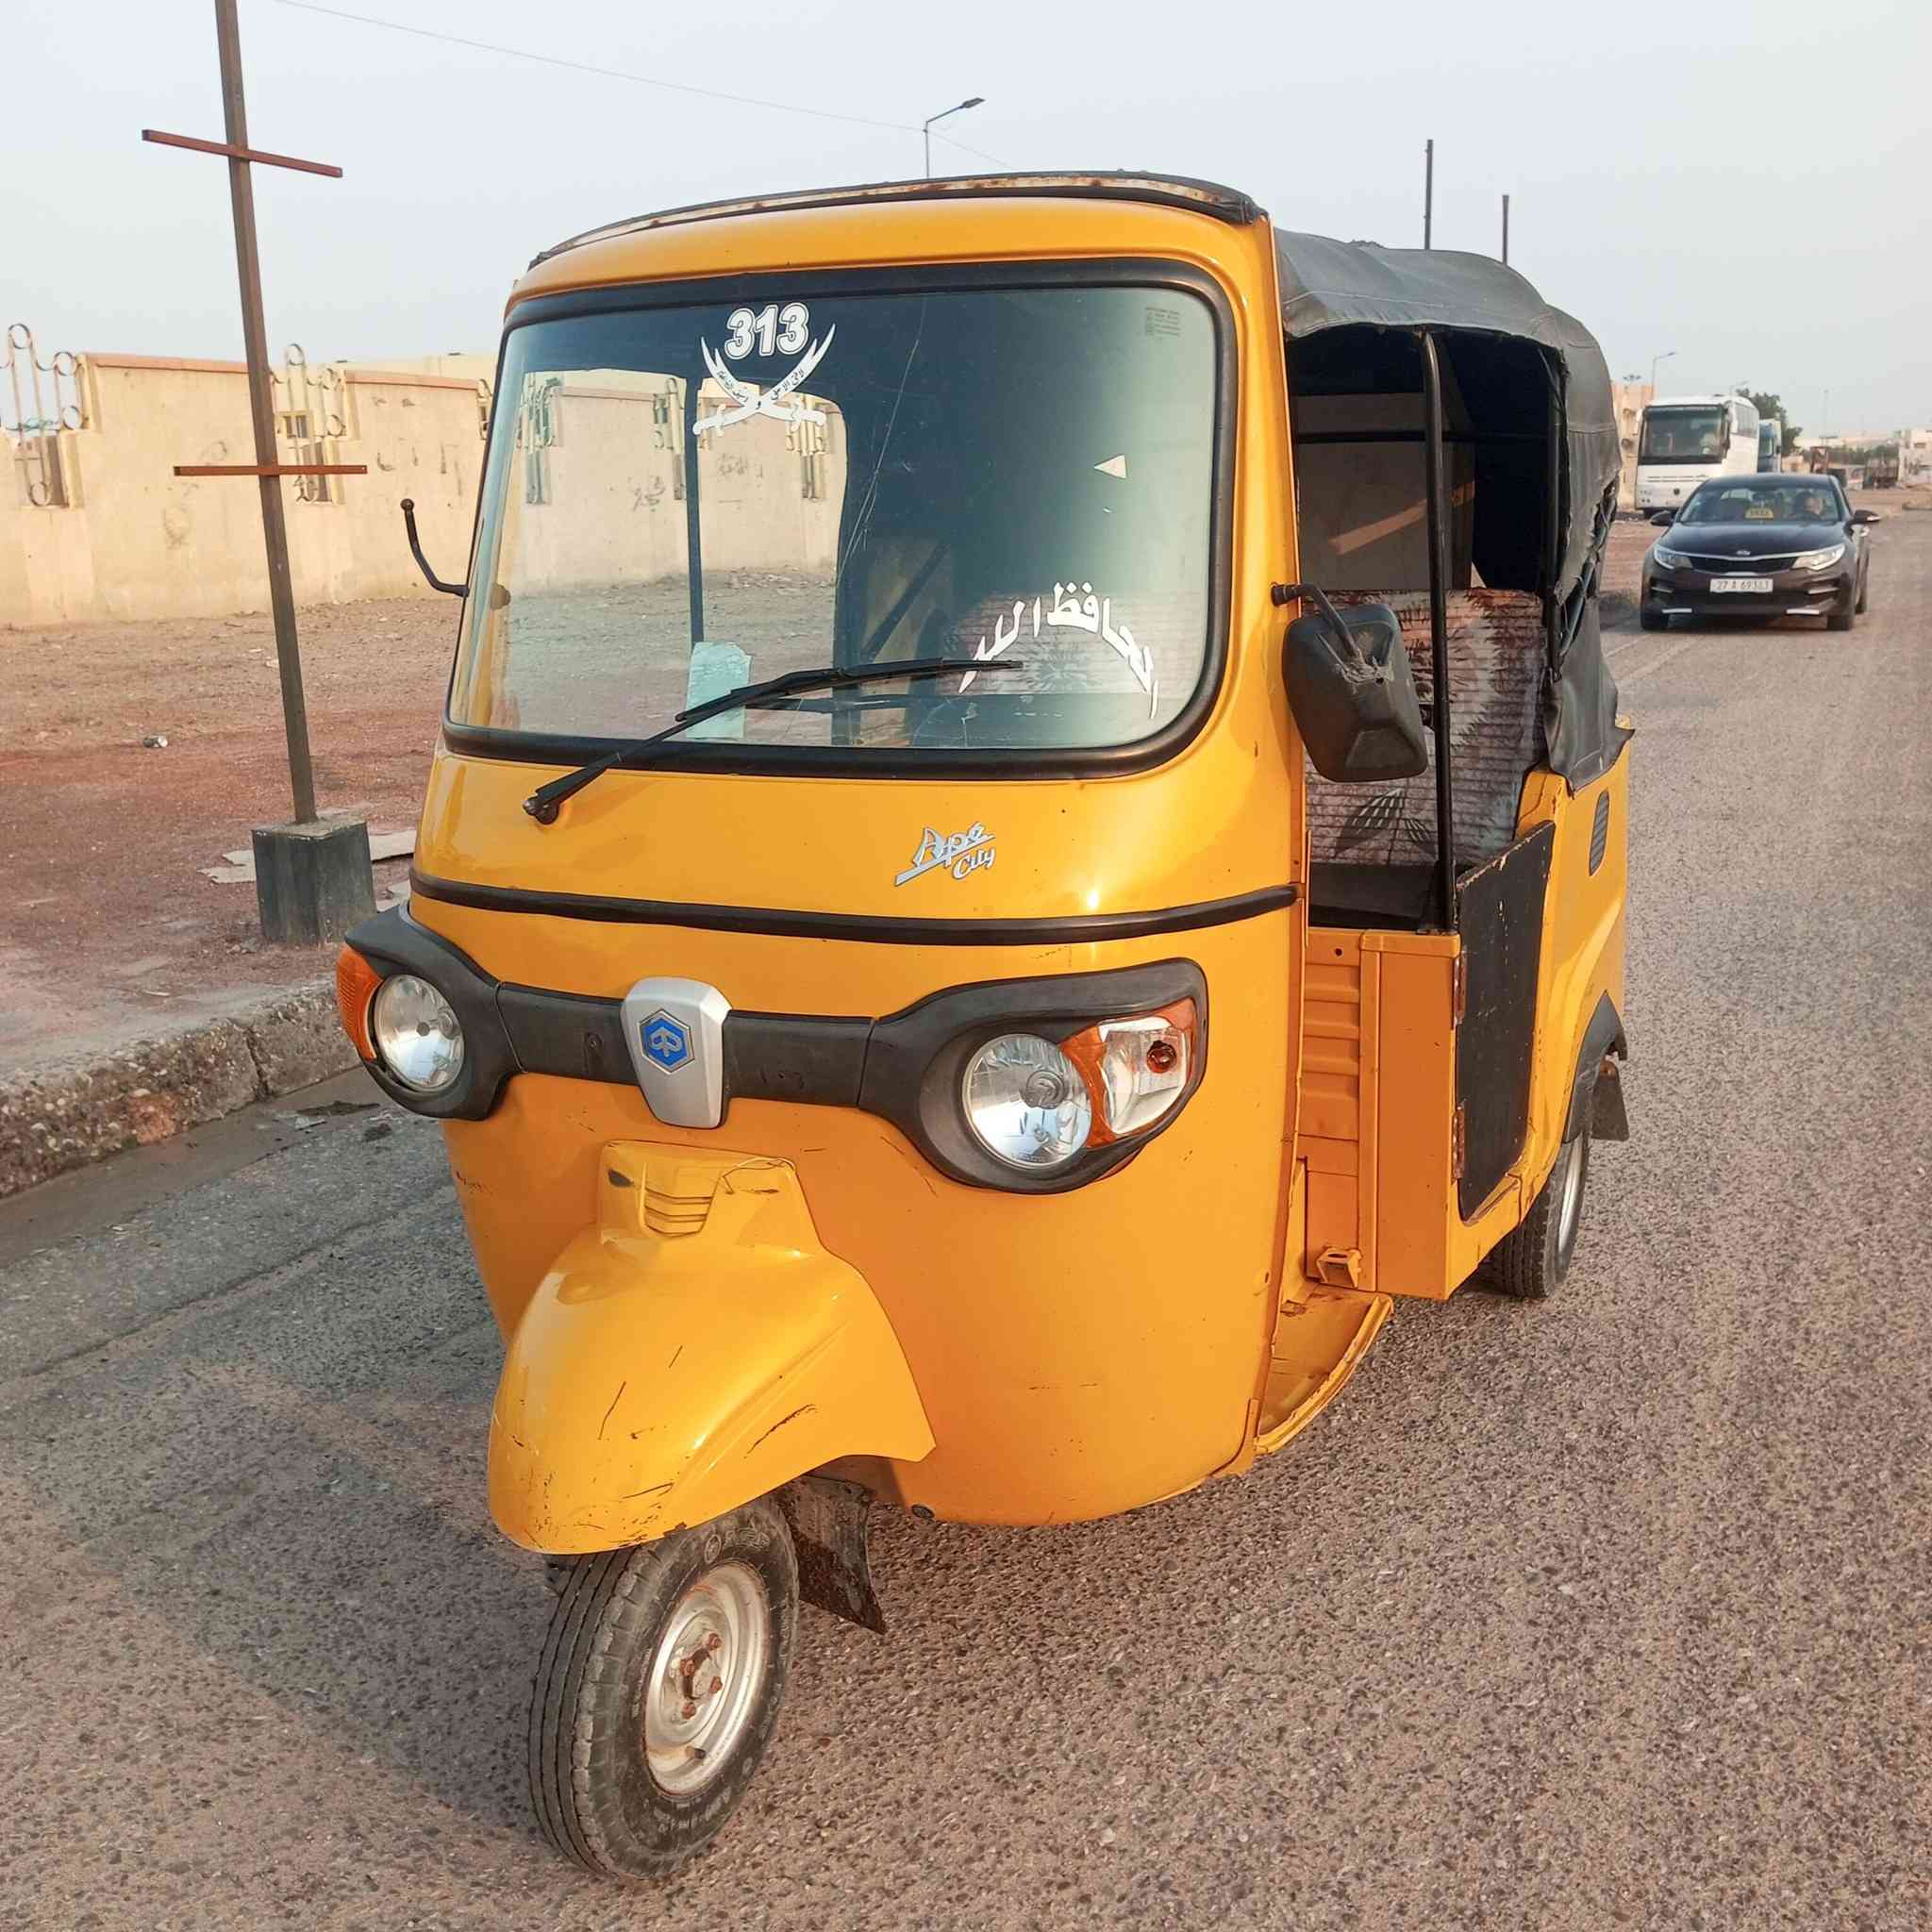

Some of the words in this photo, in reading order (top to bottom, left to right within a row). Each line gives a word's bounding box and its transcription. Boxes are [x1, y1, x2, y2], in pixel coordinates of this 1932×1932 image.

[724, 302, 809, 359] 313
[902, 822, 989, 881] Ape
[952, 847, 996, 880] City
